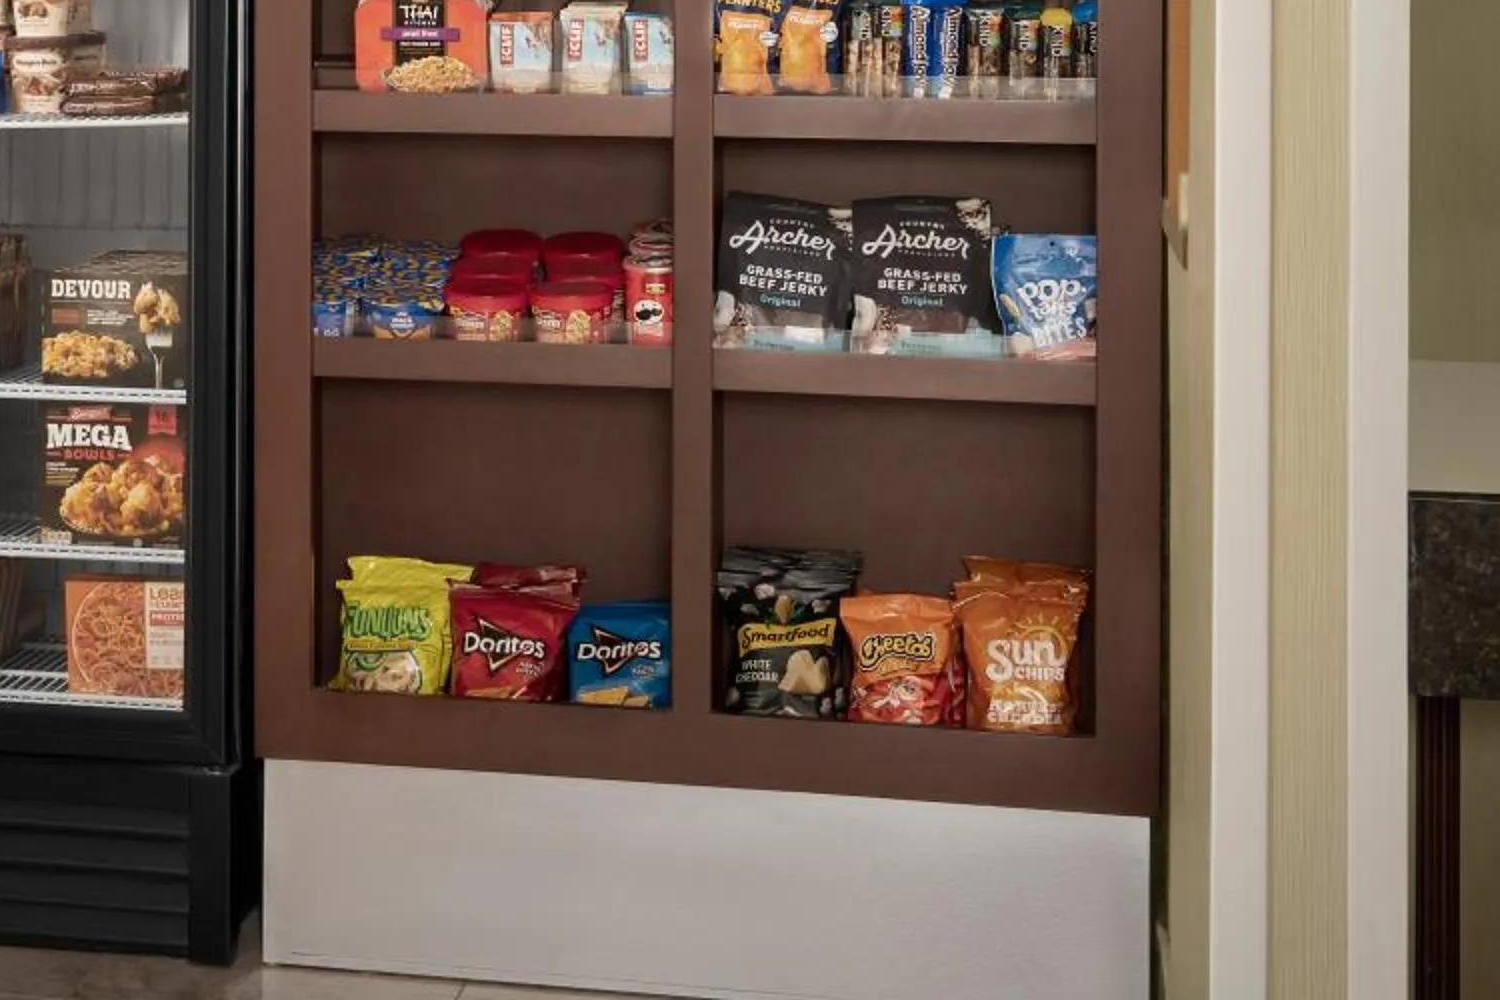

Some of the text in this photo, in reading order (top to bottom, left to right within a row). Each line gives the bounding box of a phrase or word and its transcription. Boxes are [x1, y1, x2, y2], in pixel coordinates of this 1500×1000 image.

[399, 4, 439, 20] THAI
[910, 5, 931, 61] Almond
[945, 7, 963, 59] Almond
[729, 219, 837, 261] Archer
[861, 223, 971, 260] Archer
[739, 273, 829, 298] BEEF JERKY
[746, 264, 824, 285] GRASS-FED
[883, 267, 962, 283] GRASS-FED
[51, 278, 132, 300] DEVOUR
[876, 279, 968, 295] BEEF JERKY
[759, 292, 801, 309] Original
[901, 295, 944, 307] Original
[46, 423, 133, 452] MEGA
[63, 450, 117, 461] BOWLS
[463, 631, 546, 660] Doritos
[742, 623, 830, 650] Smartfood
[577, 641, 661, 661] Doritos
[860, 632, 937, 672] Cheetos
[986, 639, 1067, 683] Sun
[742, 660, 772, 671] WHITE
[1013, 667, 1065, 682] CHIPS
